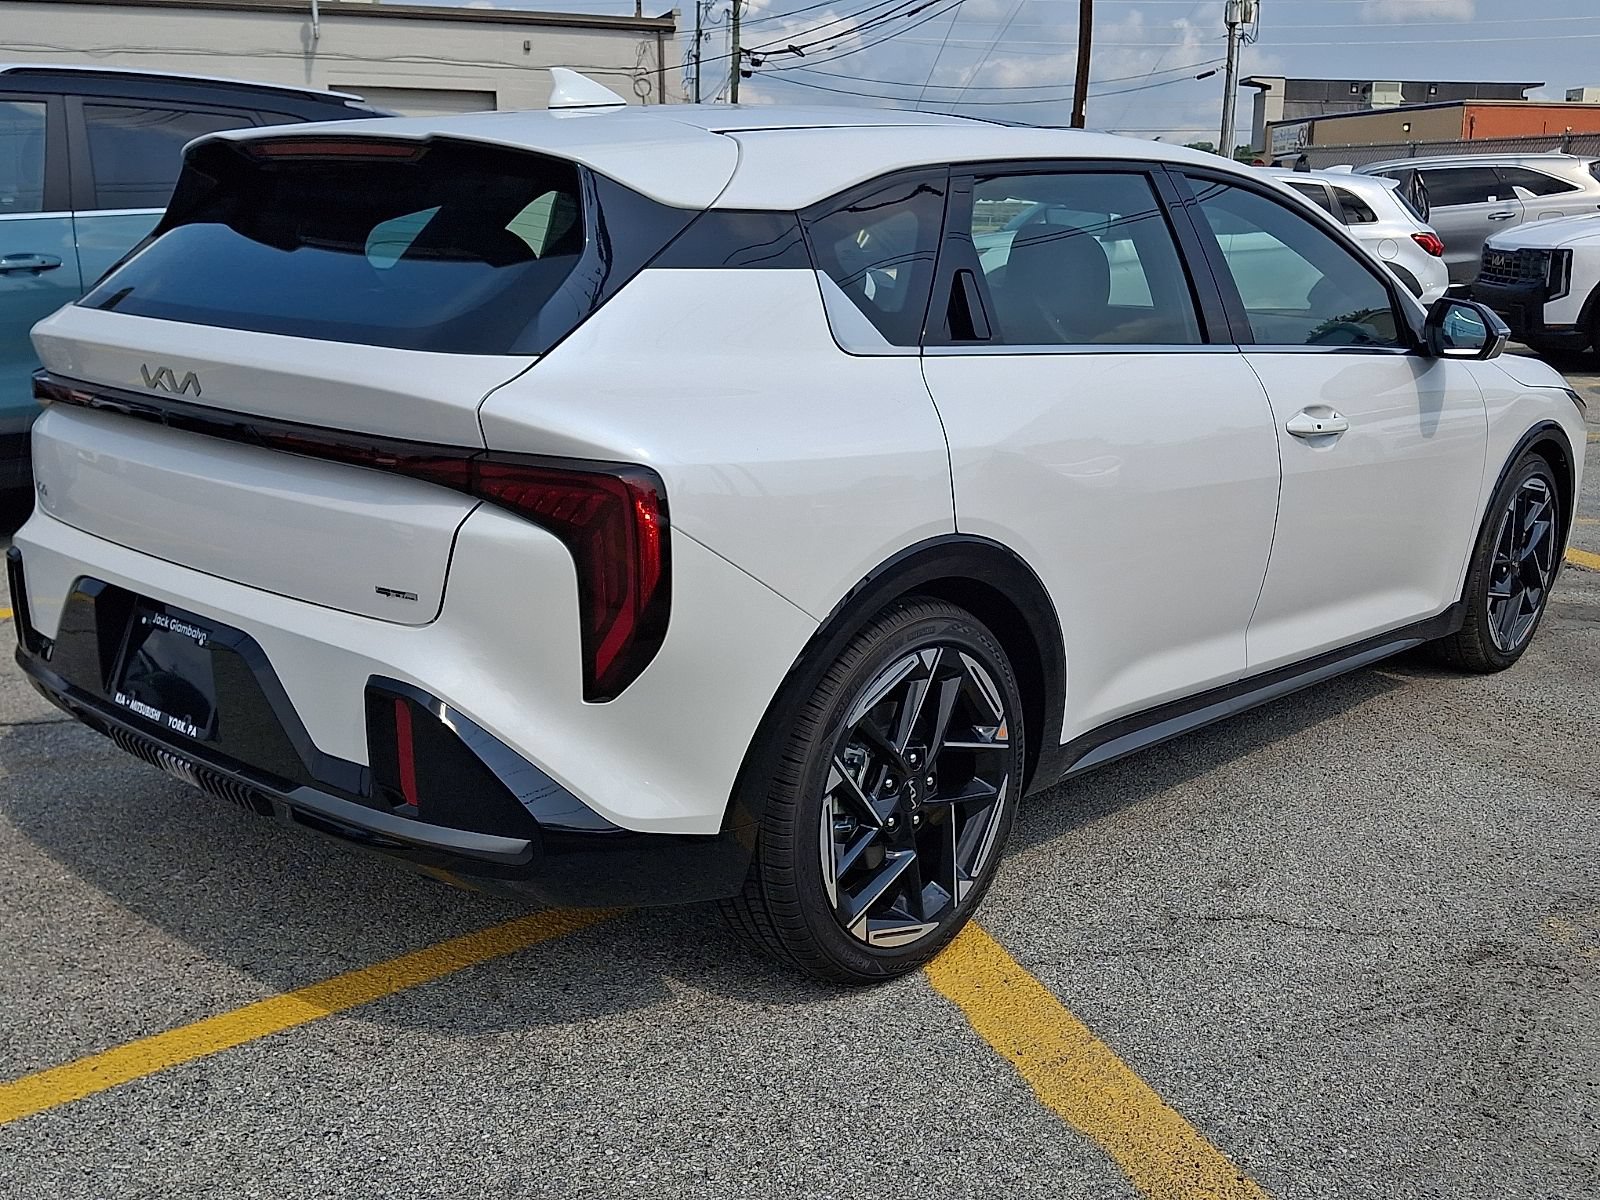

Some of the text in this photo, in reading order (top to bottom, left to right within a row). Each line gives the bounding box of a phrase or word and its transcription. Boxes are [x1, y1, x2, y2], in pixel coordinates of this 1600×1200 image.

[140, 362, 202, 397] KIA
[152, 612, 207, 642] Jack Giambalvo
[115, 692, 126, 706] KIA
[129, 700, 161, 721] MITSUBISHI
[187, 724, 197, 738] PA
